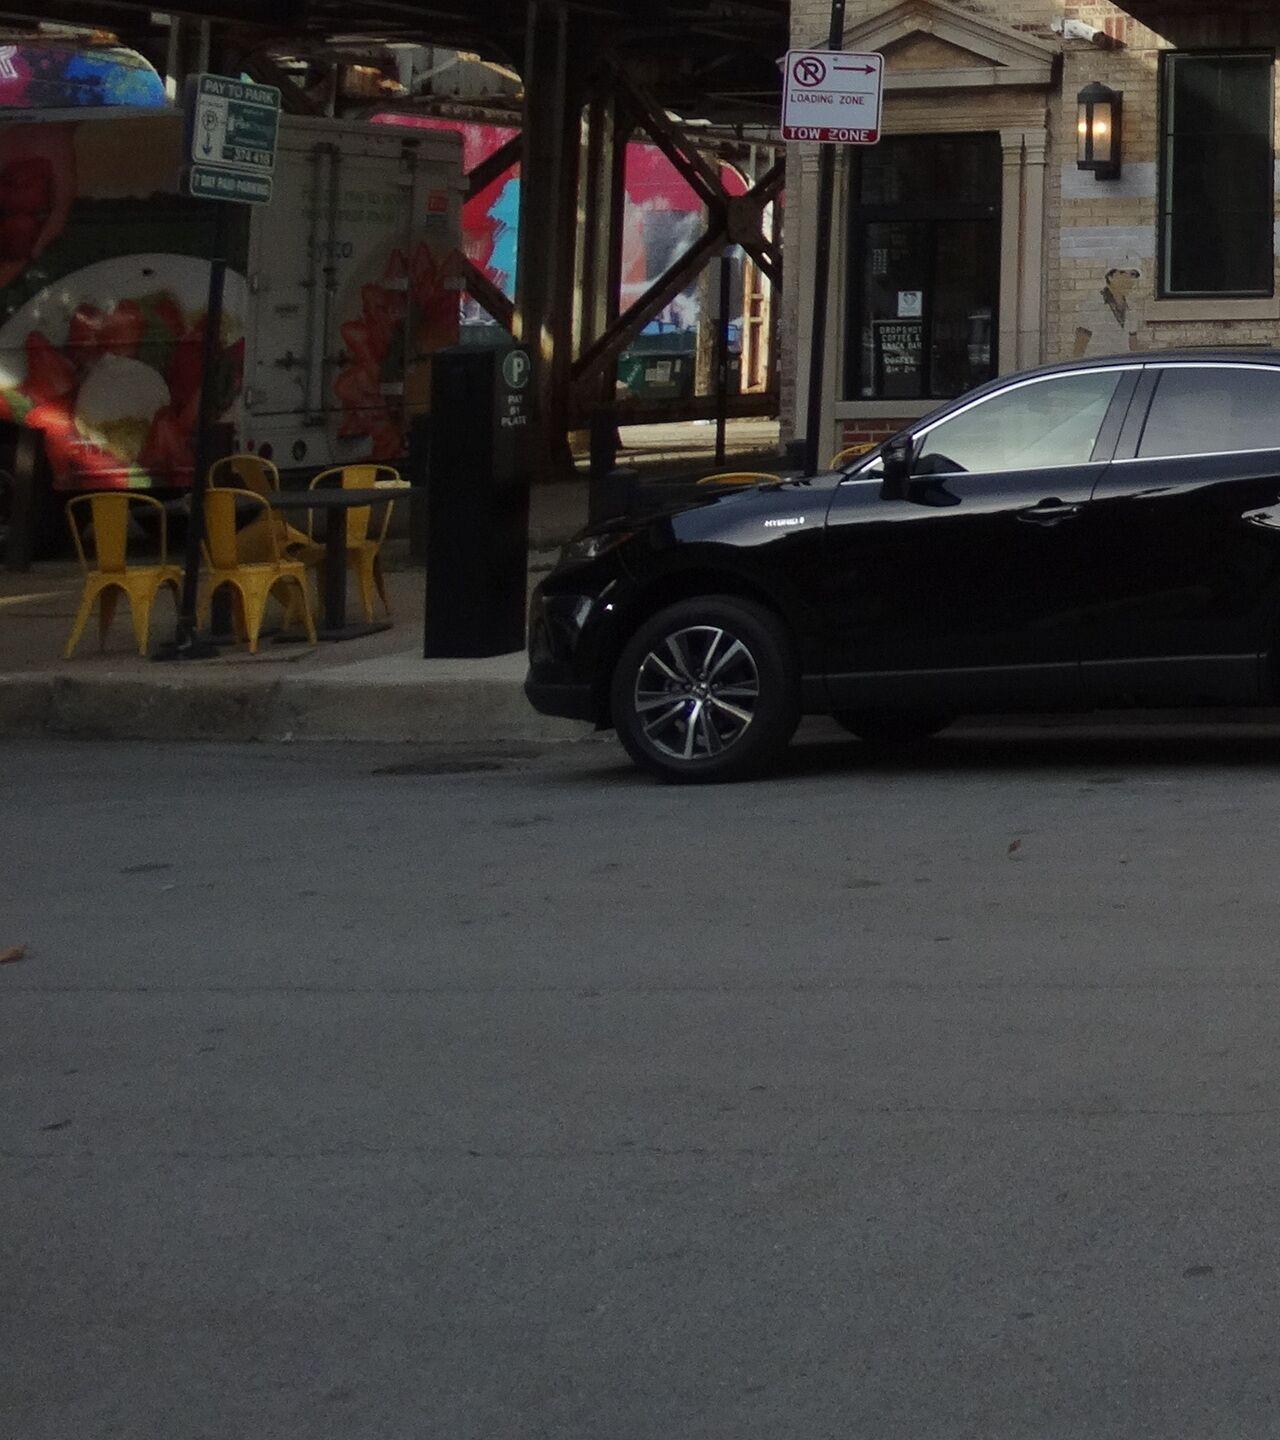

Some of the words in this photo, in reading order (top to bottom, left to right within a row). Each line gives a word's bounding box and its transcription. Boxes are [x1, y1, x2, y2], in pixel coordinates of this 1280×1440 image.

[205, 79, 225, 95] PAY
[228, 83, 243, 98] TO
[245, 87, 274, 105] PARK
[790, 93, 834, 104] LOADING
[840, 95, 865, 106] ZONE
[789, 127, 821, 140] TOW
[828, 128, 870, 141] ZONE
